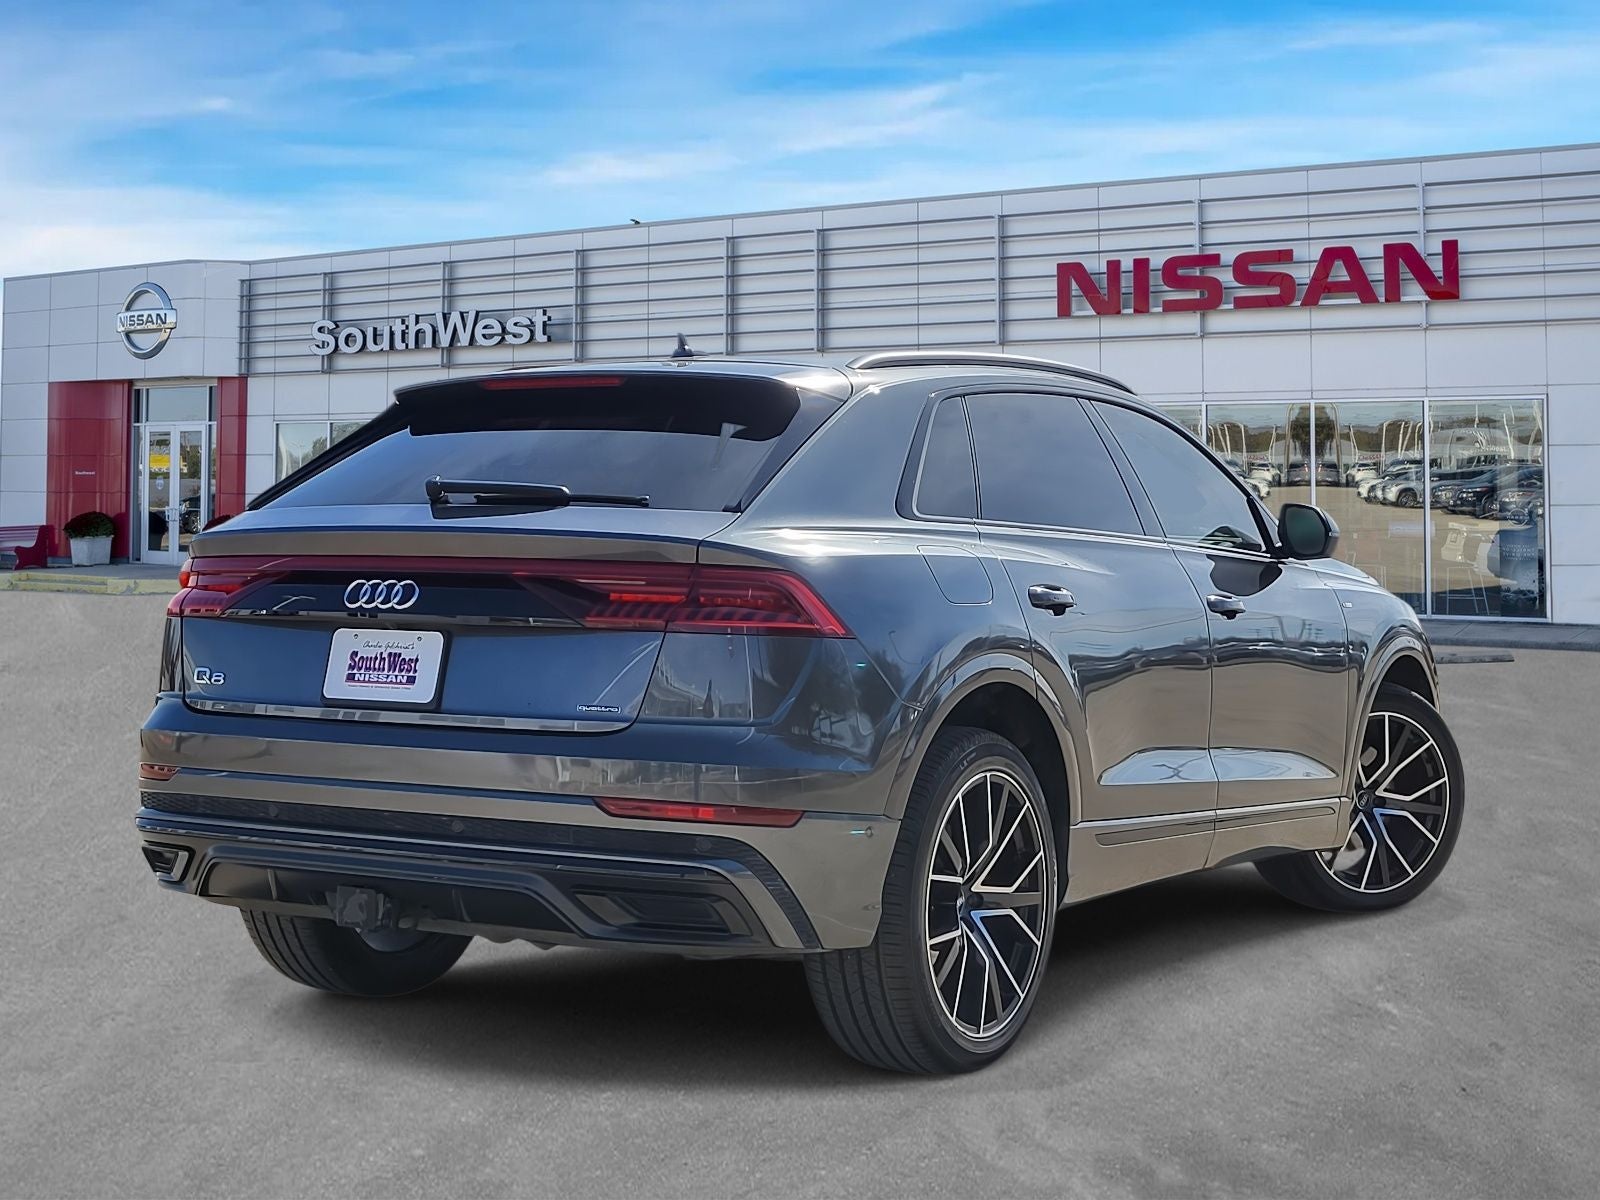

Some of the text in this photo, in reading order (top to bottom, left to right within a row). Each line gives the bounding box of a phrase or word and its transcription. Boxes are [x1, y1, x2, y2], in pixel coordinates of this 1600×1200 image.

[1057, 240, 1460, 317] NISSAN
[119, 313, 167, 327] NISSAN
[309, 308, 551, 356] SouthWest
[193, 667, 225, 685] Q8
[354, 673, 408, 683] NISSAN
